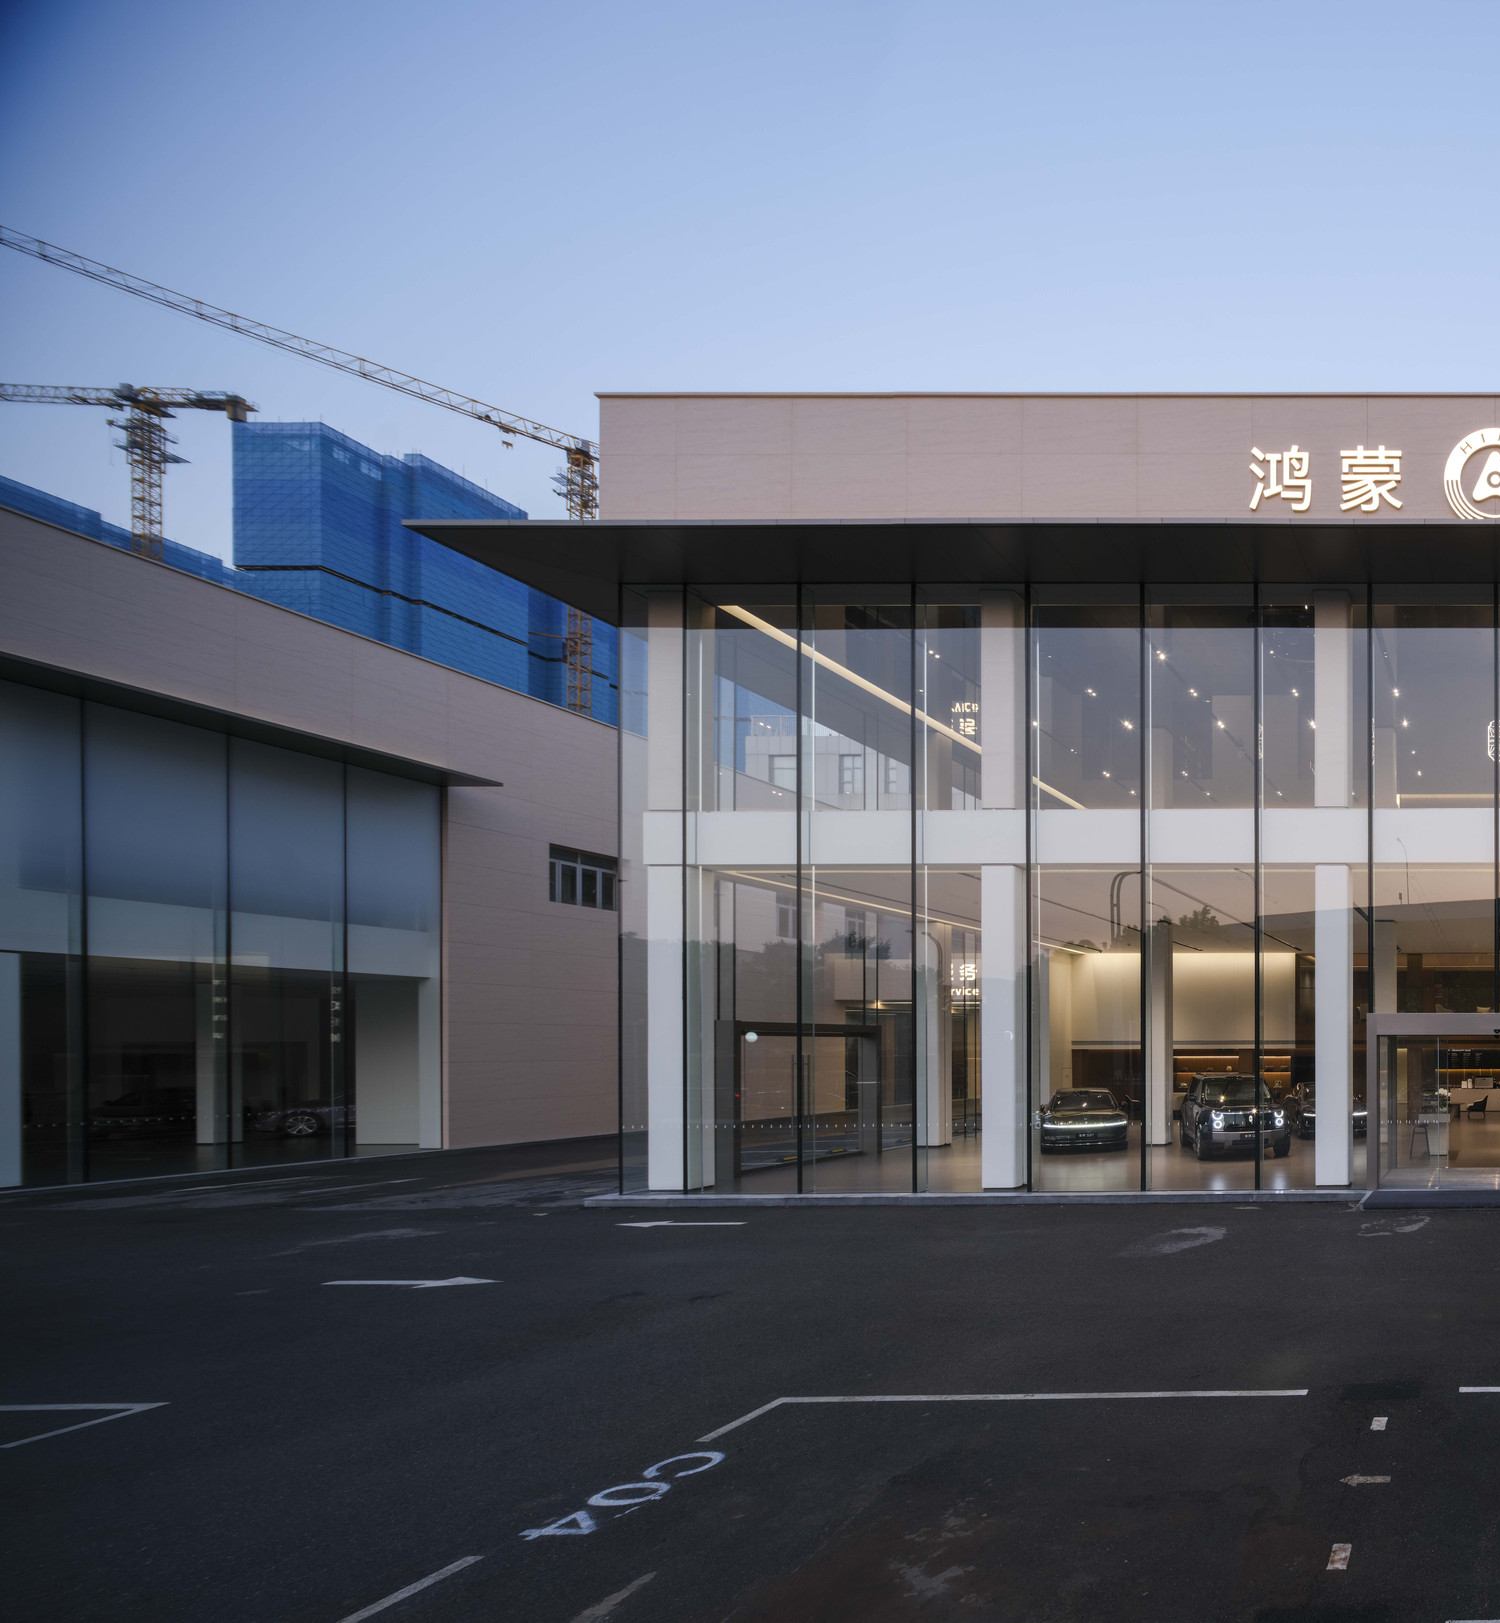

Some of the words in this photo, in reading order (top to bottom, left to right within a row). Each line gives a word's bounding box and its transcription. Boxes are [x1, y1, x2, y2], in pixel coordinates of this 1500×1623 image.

[1248, 444, 1404, 512] 鸿蒙
[951, 986, 980, 996] rvice
[517, 1450, 727, 1541] C04
